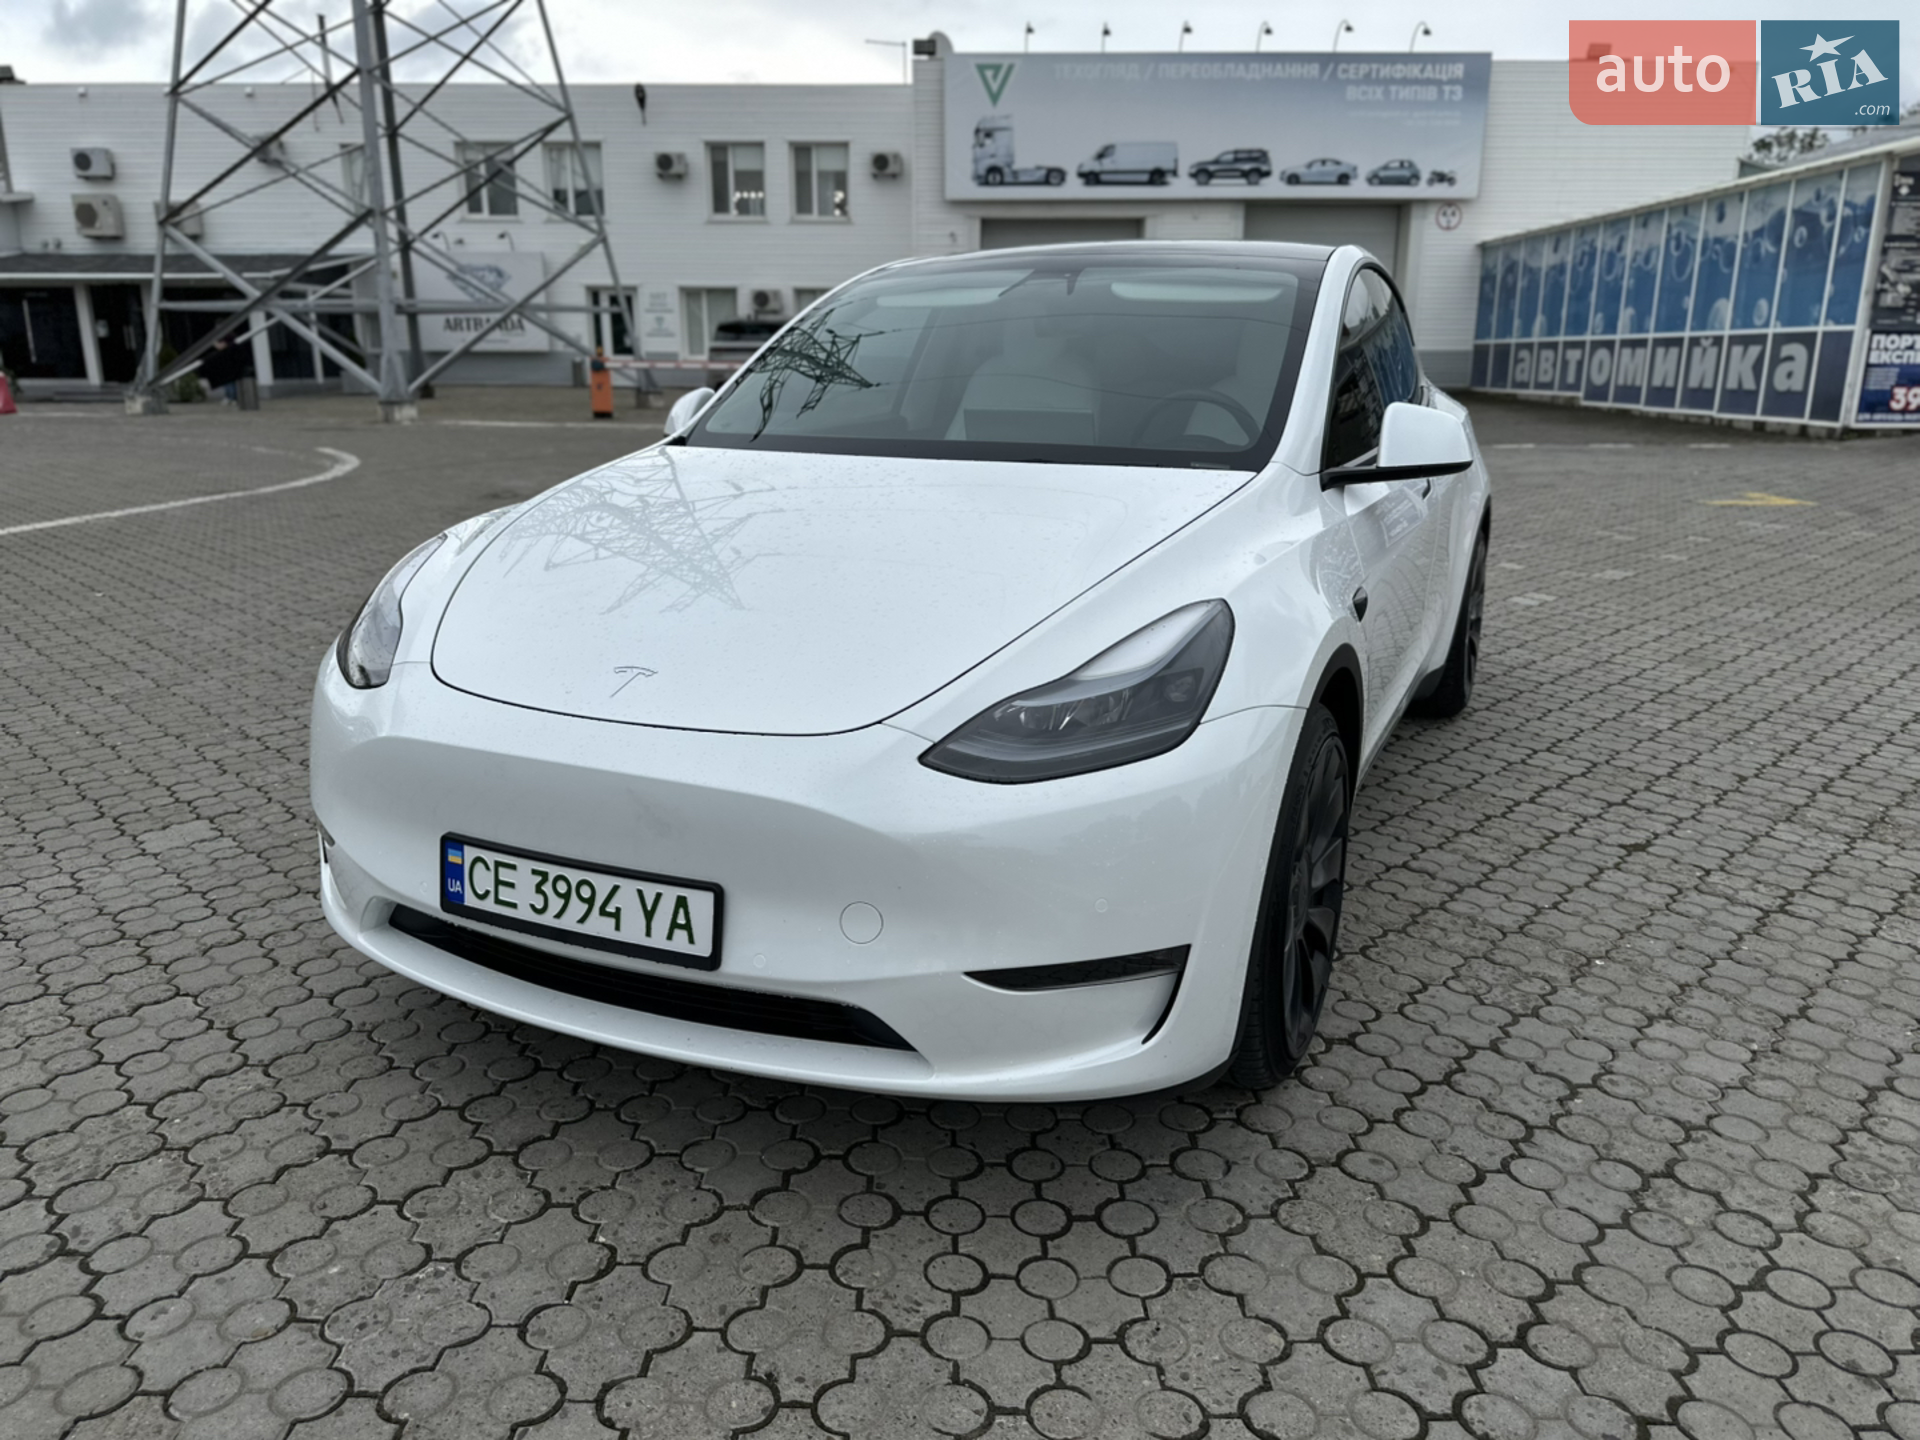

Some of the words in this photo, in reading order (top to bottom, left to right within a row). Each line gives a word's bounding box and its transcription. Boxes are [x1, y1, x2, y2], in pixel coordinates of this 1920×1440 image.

[1158, 62, 1320, 81] ПЕРЕОБЛАДНАННЯ
[1336, 62, 1465, 81] СЕРТИФІКАЦІЯ
[1346, 84, 1385, 101] ВСІХ
[1389, 84, 1438, 101] ТИПІВ
[1514, 338, 1808, 392] автомийка
[448, 878, 463, 894] UA
[468, 855, 518, 910] CE
[529, 868, 622, 932] 3994
[636, 887, 696, 945] YA
